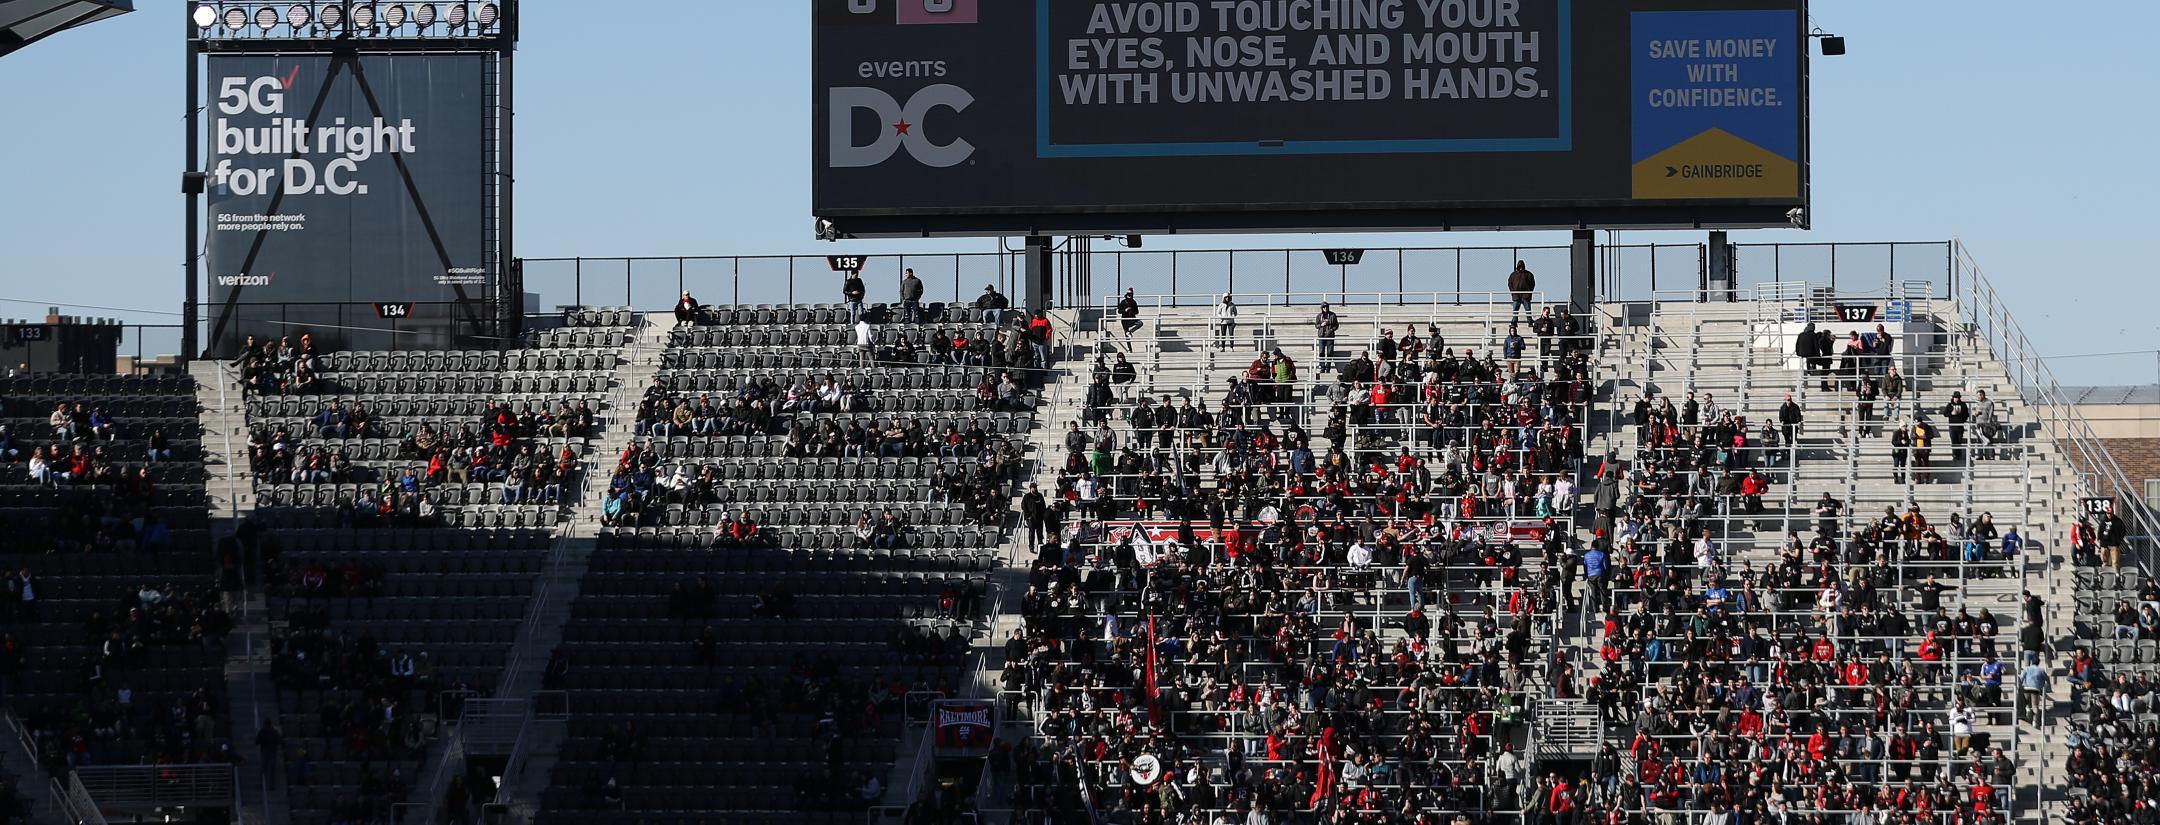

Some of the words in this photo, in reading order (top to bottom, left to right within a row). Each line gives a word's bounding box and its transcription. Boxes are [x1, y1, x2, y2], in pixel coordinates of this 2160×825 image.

[1086, 2, 1200, 34] AVOID
[1211, 0, 1404, 32] TOUCHING
[1418, 0, 1520, 28] YOUR
[1068, 37, 1174, 72] EYES,
[1186, 35, 1297, 70] NOSE,
[1308, 34, 1390, 66] AND
[1403, 31, 1539, 64] MOUTH
[1649, 40, 1701, 59] SAVE
[1705, 38, 1777, 58] MONEY
[1686, 64, 1738, 83] WITH
[1058, 73, 1158, 105] WITH
[1171, 69, 1391, 103] UNWASHED
[1404, 66, 1549, 99] HANDS.
[218, 76, 284, 115] 5G
[1648, 87, 1783, 108] CONFIDENCE.
[829, 83, 976, 168] DC
[217, 117, 310, 155] built
[317, 116, 416, 162] right
[215, 159, 275, 196] for
[283, 158, 368, 196] D.C.
[1681, 164, 1763, 179] GAINBRIDGE
[217, 213, 232, 222] 5G
[232, 213, 253, 222] from
[253, 213, 269, 222] the
[269, 213, 305, 222] network
[217, 223, 241, 231] more
[241, 222, 272, 232] people
[272, 222, 289, 232] rely
[289, 222, 304, 230] on.
[836, 257, 858, 269] 135
[1332, 251, 1354, 262] 136
[217, 272, 269, 286] verizon
[382, 305, 405, 316] 134
[1844, 308, 1868, 320] 137
[20, 327, 41, 338] 133
[2086, 499, 2111, 513] 138
